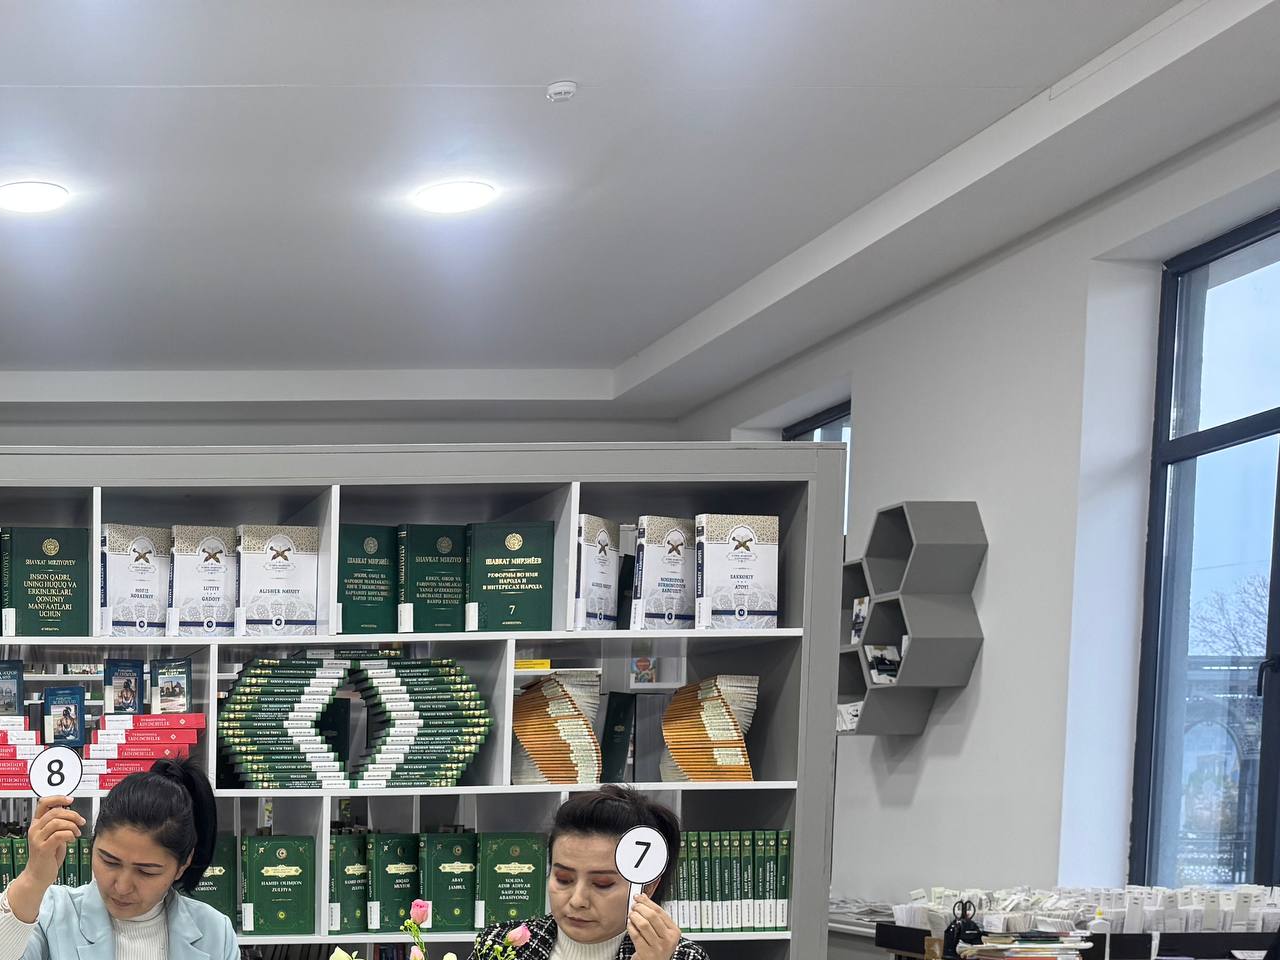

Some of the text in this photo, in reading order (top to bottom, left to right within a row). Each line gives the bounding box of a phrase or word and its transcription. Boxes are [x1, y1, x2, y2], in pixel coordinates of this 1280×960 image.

[508, 605, 516, 615] 7
[46, 758, 66, 787] 8
[633, 840, 651, 869] 7
